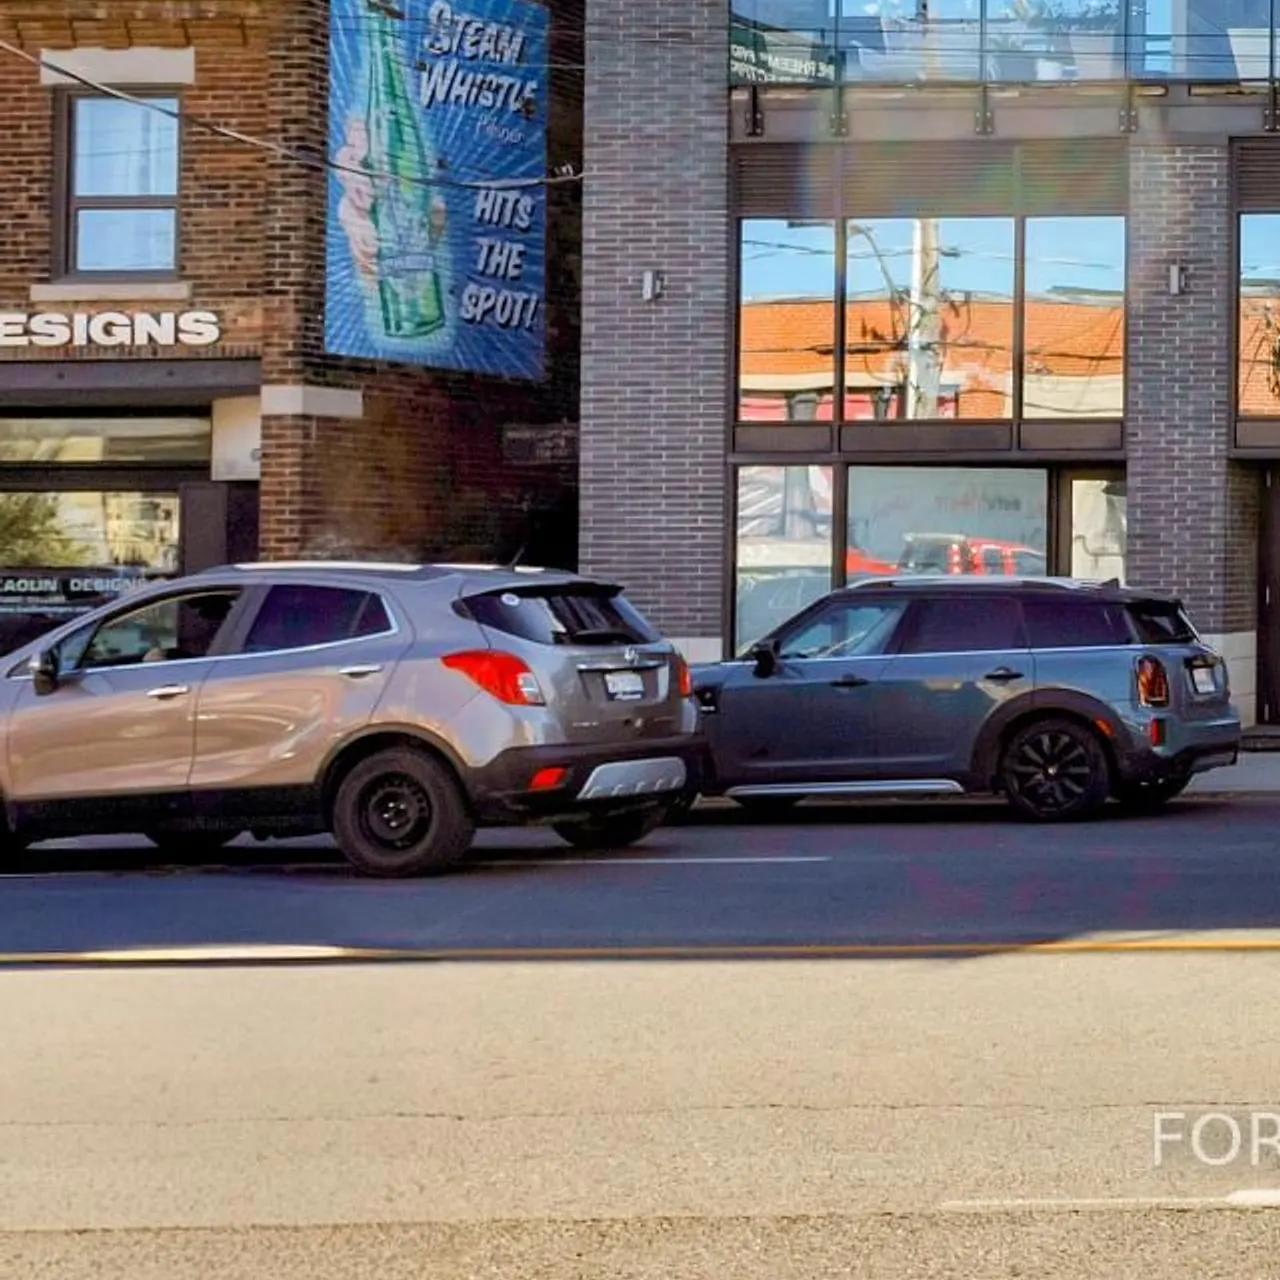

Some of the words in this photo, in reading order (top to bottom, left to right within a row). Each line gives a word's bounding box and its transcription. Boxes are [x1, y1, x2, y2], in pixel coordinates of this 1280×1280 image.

[423, 0, 526, 65] STEAM
[419, 59, 539, 113] WHISTLE
[475, 189, 536, 231] HITS
[475, 237, 527, 280] THE
[460, 282, 540, 332] SPOT!
[0, 311, 220, 347] ESIGNS
[0, 578, 58, 592] AOLIN
